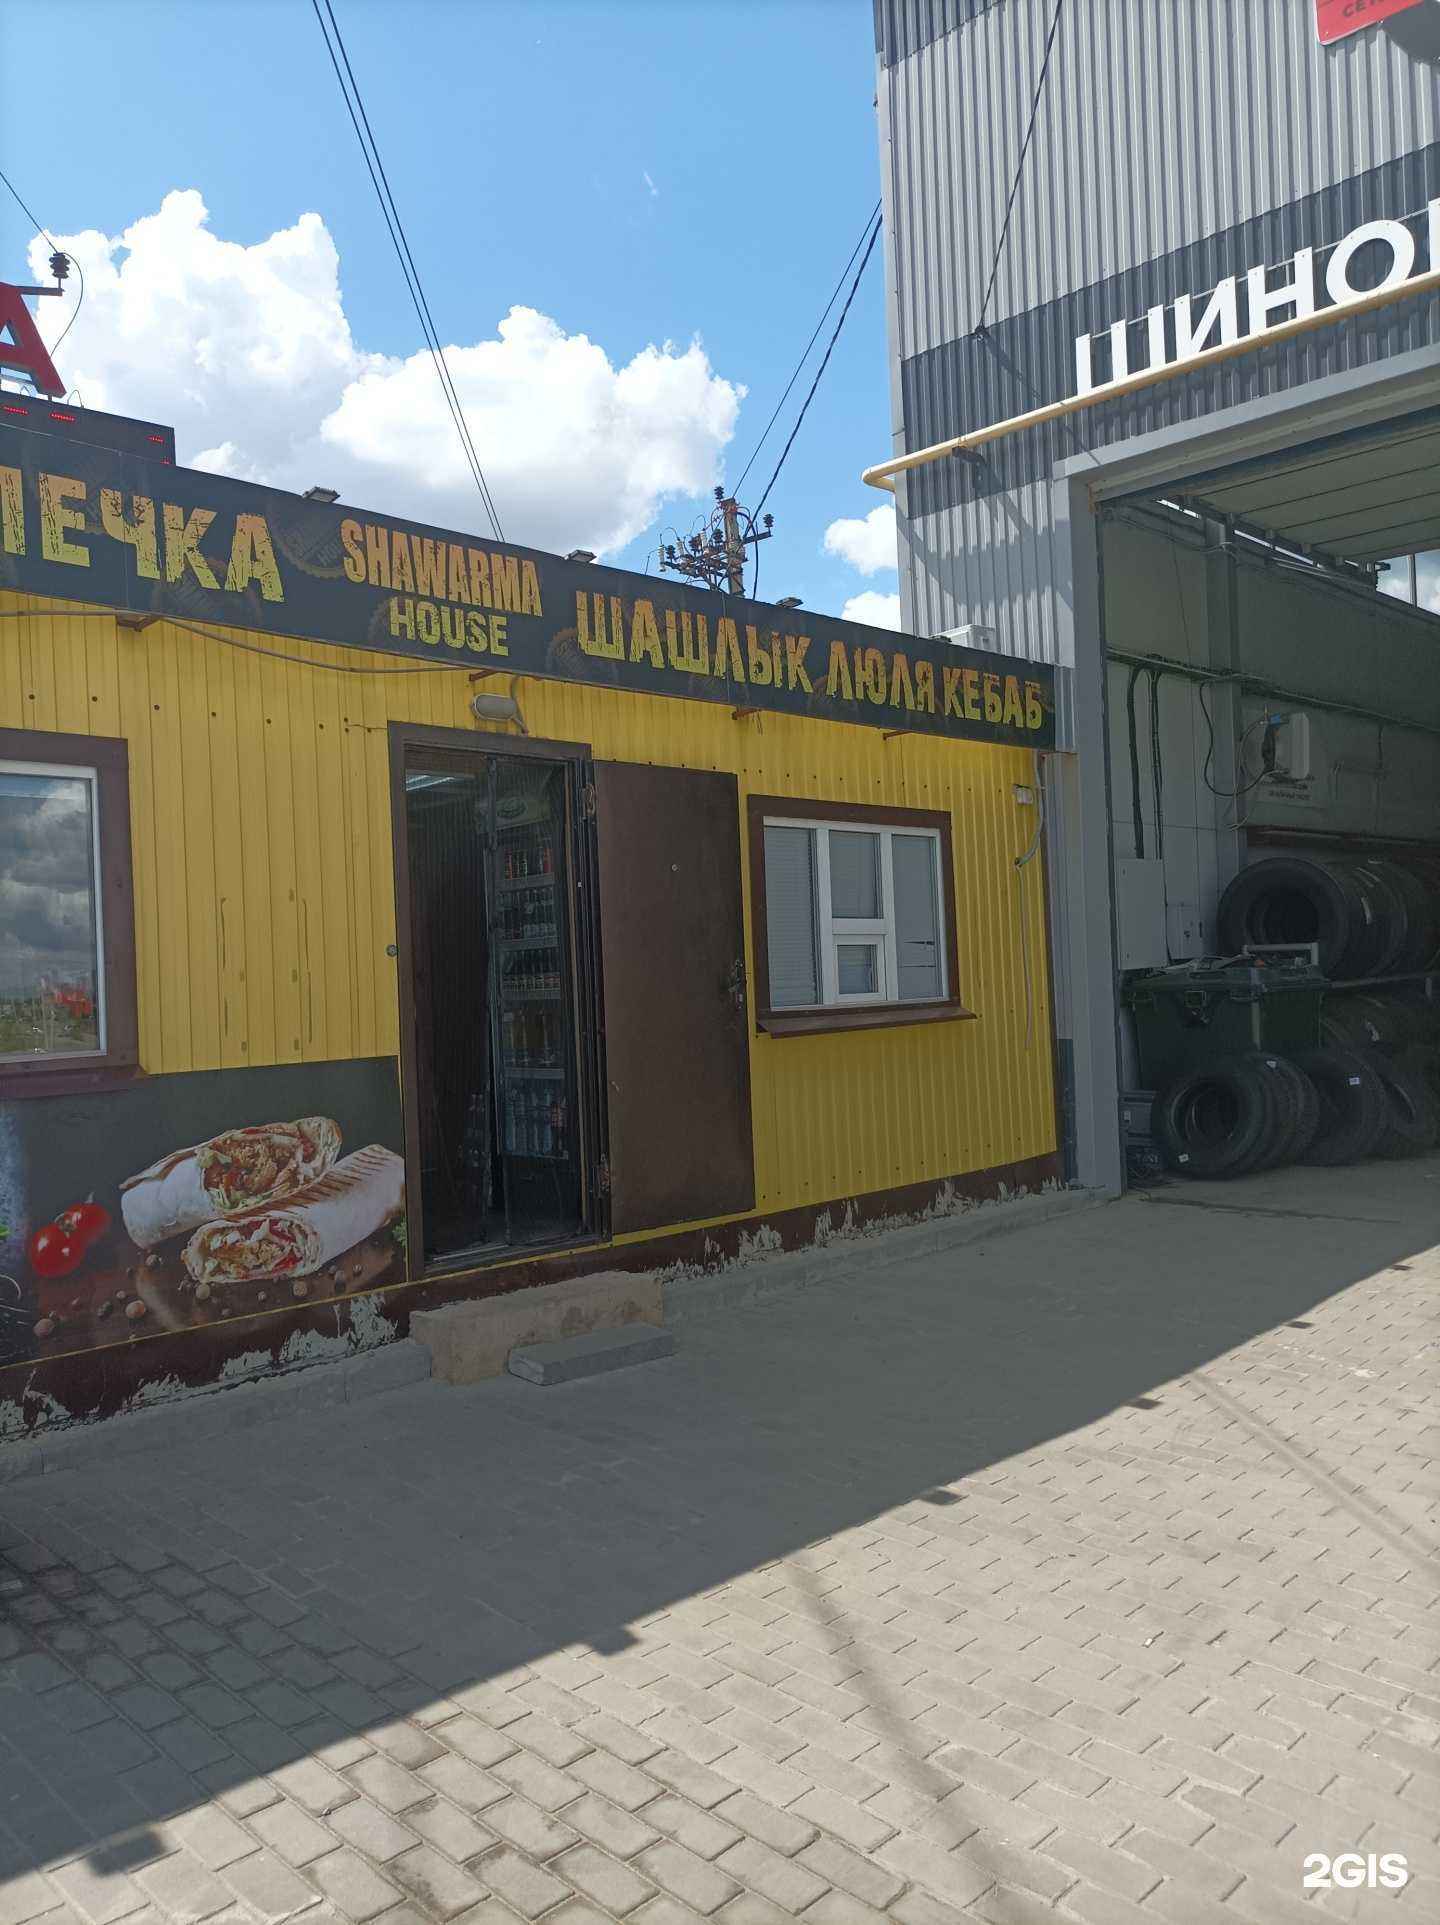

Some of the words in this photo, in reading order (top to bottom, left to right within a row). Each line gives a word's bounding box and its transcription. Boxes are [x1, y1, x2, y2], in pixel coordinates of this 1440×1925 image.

[1075, 198, 1440, 396] ШИНО
[340, 518, 543, 617] SHAWARMA
[389, 597, 509, 657] HOUSE
[576, 590, 814, 693] ШАШЛЫК
[826, 639, 936, 714] ЛЮЛЯ
[942, 666, 1043, 730] КЕБАБ
